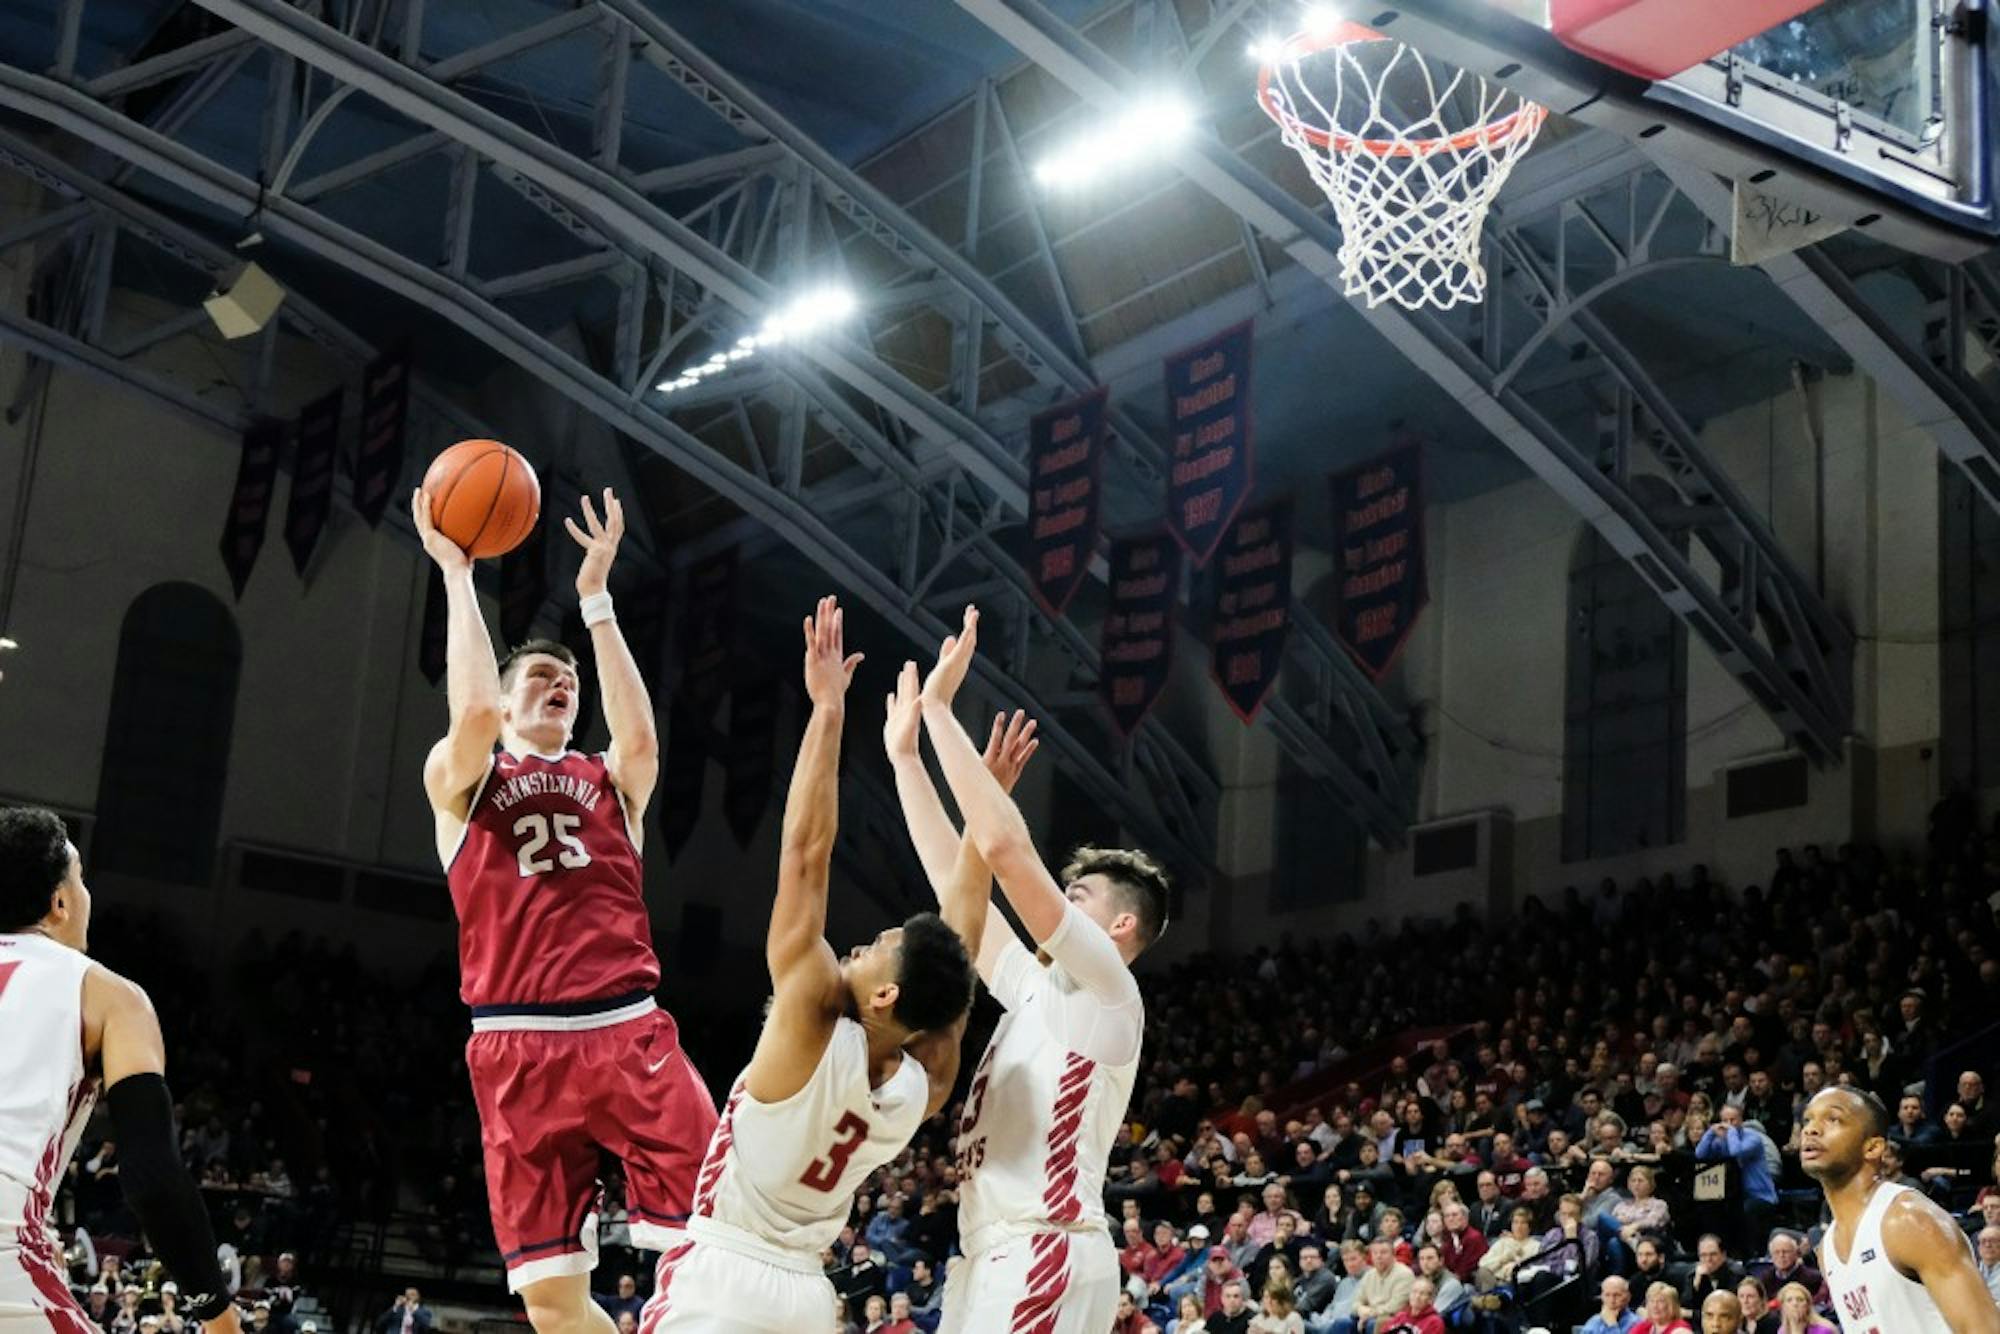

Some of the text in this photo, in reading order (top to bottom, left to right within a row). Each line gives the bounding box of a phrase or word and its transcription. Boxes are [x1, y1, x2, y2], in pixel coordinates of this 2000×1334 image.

[492, 772, 601, 811] PENNSYLVANIA
[513, 813, 592, 877] 25
[799, 1110, 869, 1193] 3
[1701, 1174, 1718, 1187] 114
